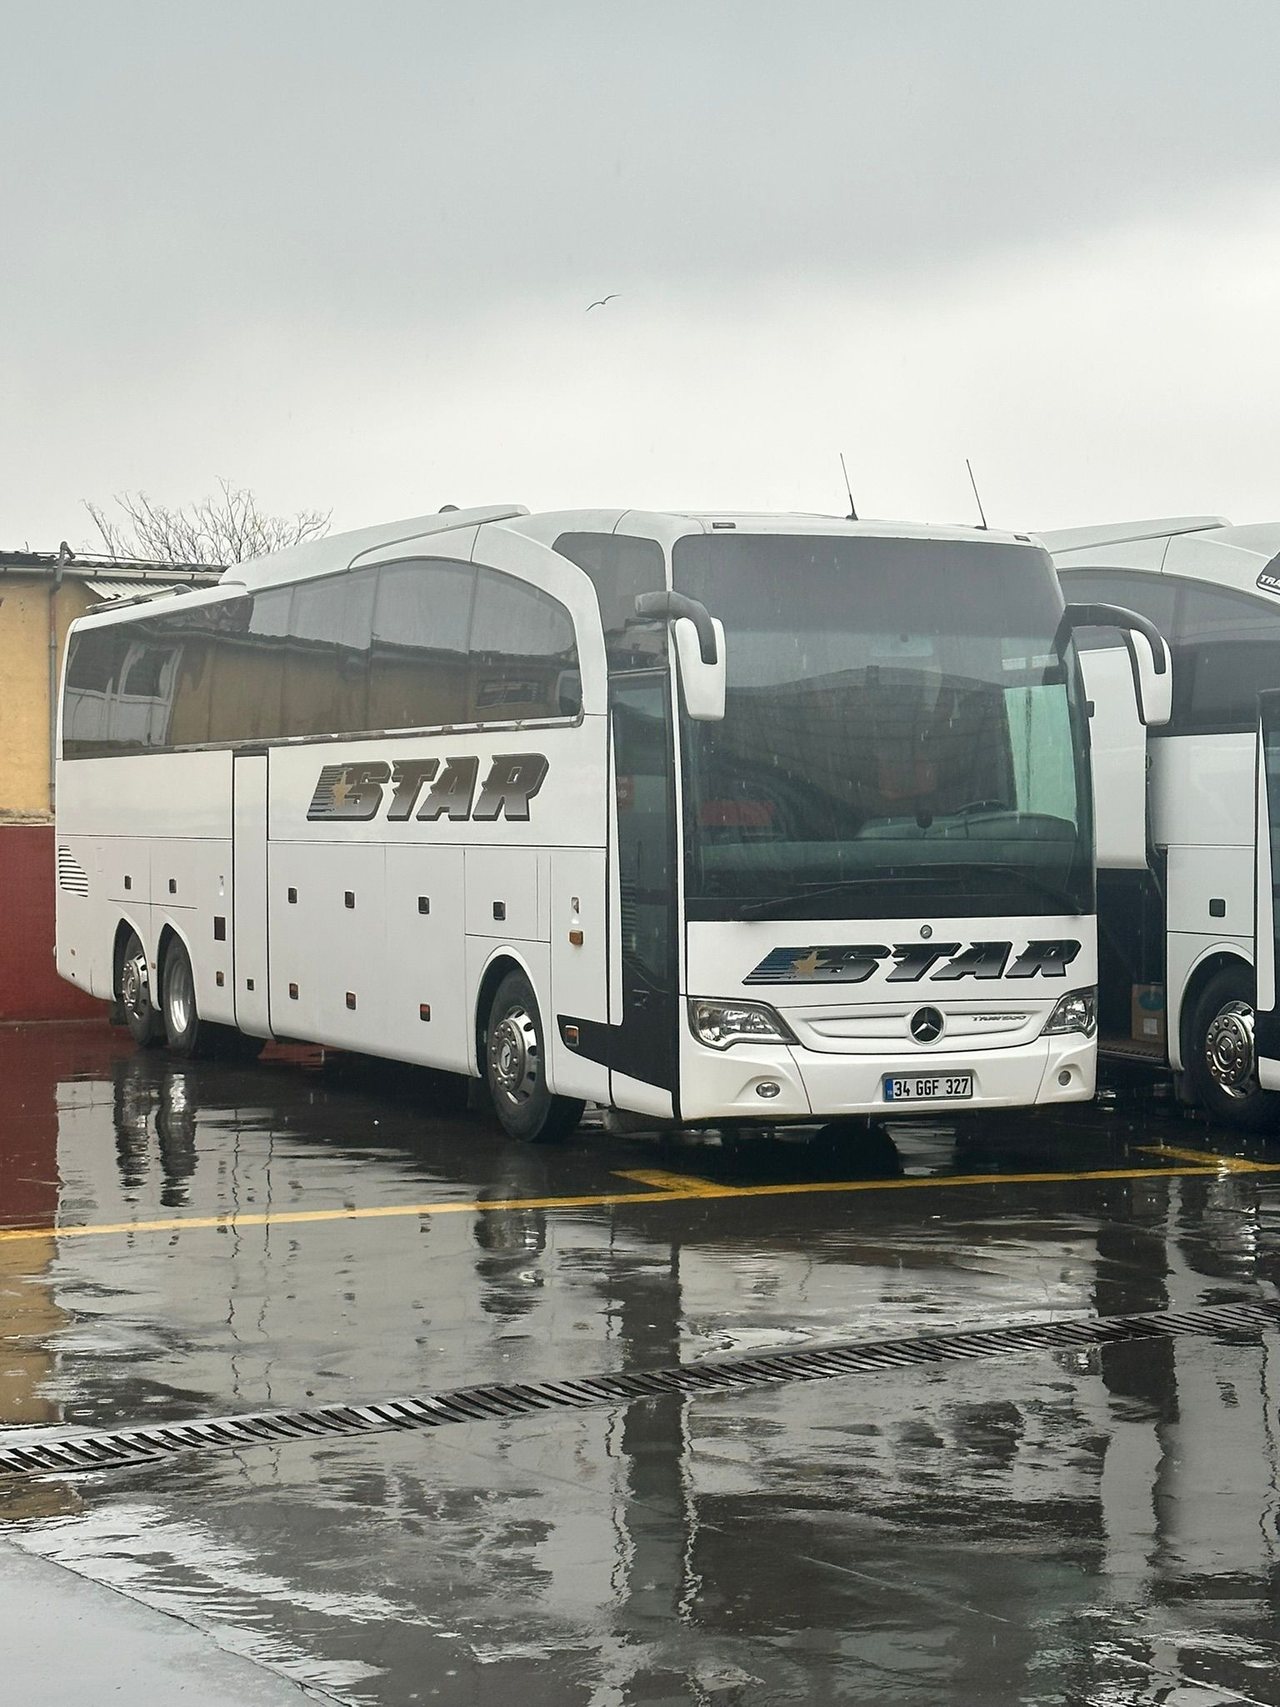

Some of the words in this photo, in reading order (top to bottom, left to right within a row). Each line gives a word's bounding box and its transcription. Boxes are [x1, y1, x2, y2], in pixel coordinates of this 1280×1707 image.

[306, 753, 549, 821] STAR
[742, 939, 1082, 985] STAR
[894, 1080, 911, 1097] 34
[916, 1080, 939, 1096] GGF
[945, 1078, 969, 1095] 327
